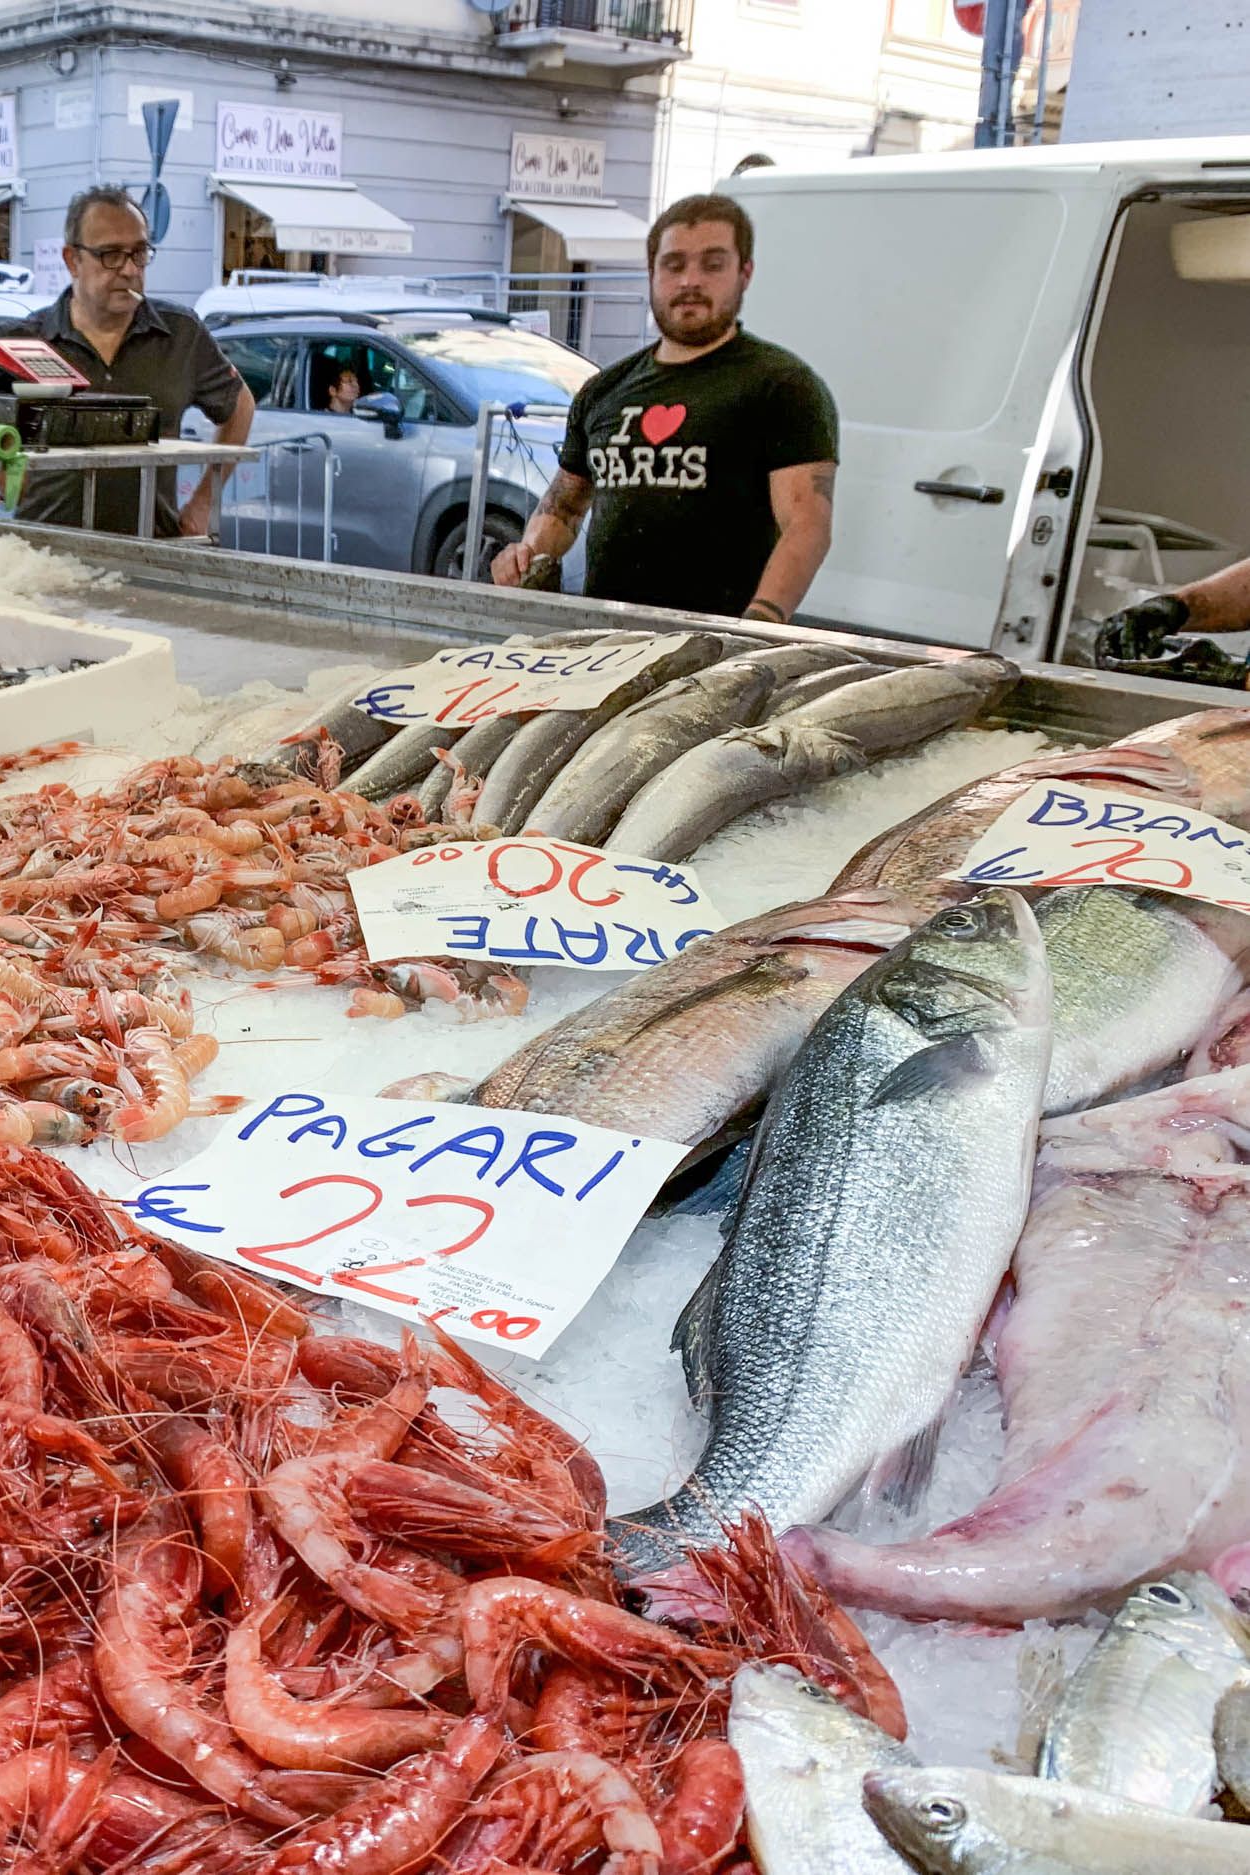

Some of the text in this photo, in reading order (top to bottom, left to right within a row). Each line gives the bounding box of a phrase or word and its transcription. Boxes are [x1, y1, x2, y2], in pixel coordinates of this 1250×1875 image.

[222, 111, 336, 158] Come Una Volta
[610, 405, 643, 445] I
[588, 446, 708, 489] PARIS
[353, 684, 428, 718] €
[1026, 789, 1250, 856] BRAN
[614, 863, 700, 904] €
[121, 1184, 225, 1234] €
